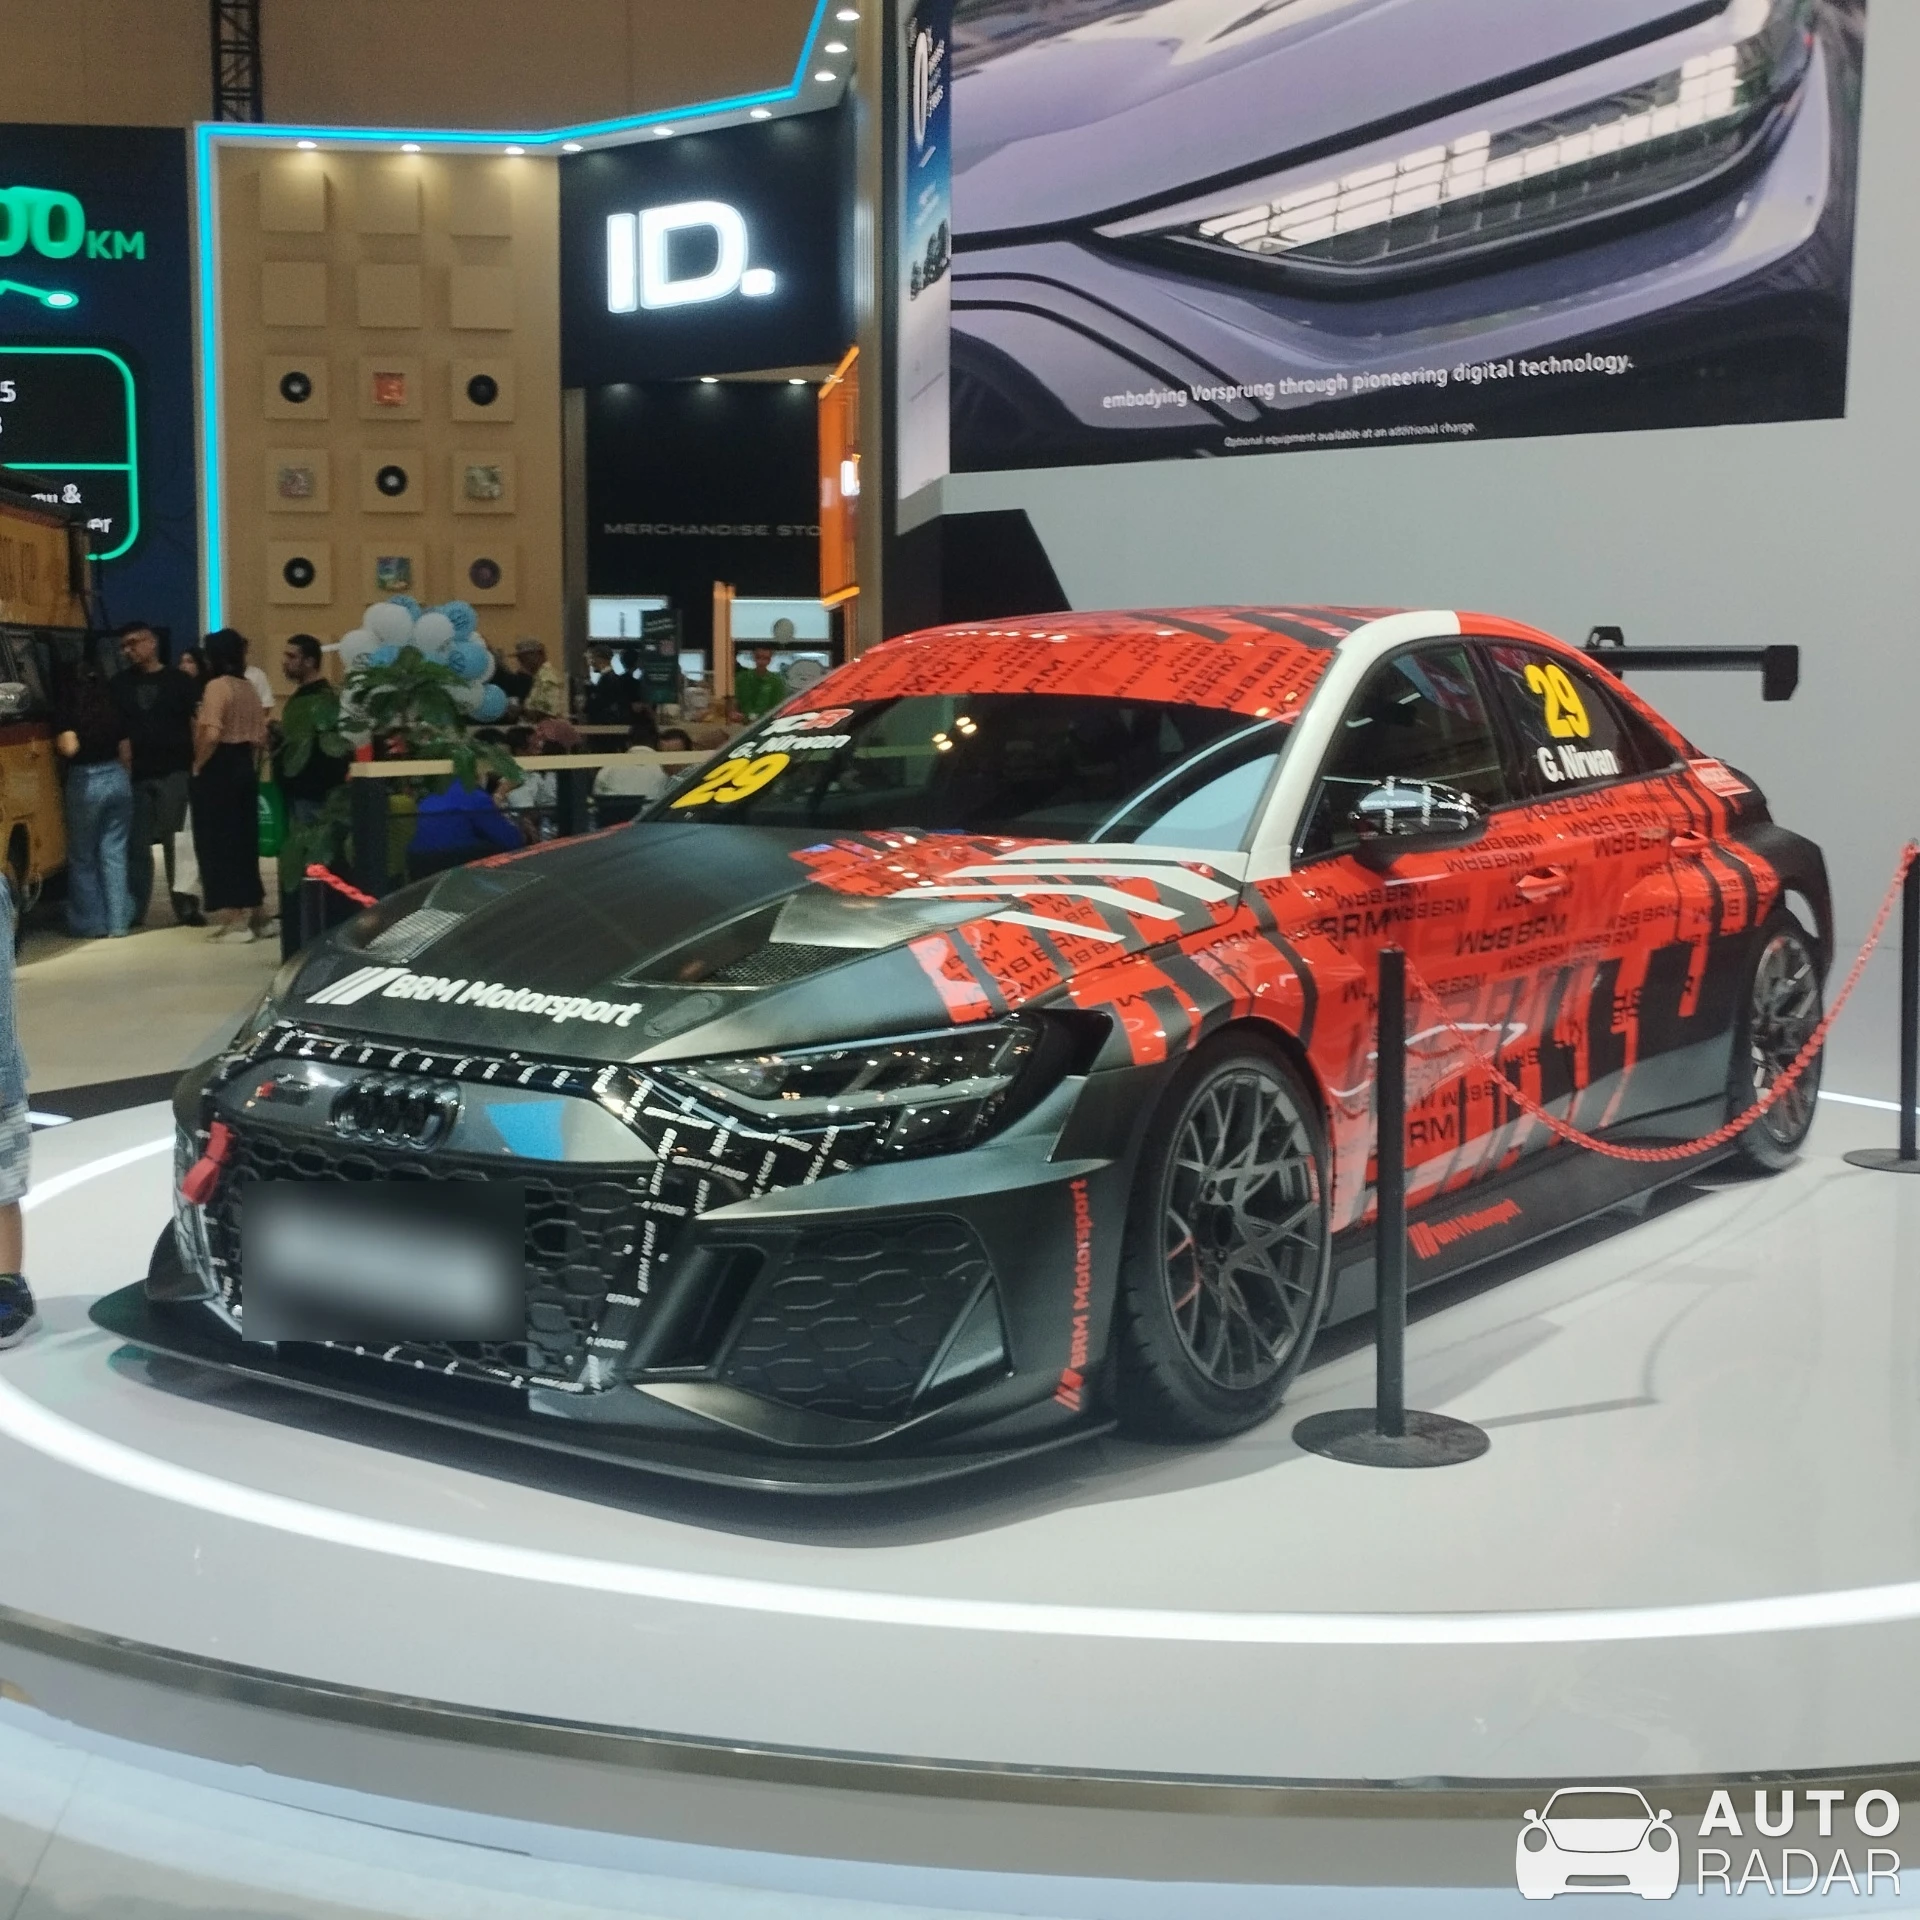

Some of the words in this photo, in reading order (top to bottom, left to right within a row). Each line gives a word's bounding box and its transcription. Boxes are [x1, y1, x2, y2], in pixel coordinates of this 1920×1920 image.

[606, 201, 776, 313] ID.
[1102, 387, 1188, 409] embodying
[1190, 380, 1275, 403] Vorsprung
[1278, 373, 1348, 397] through
[1352, 366, 1448, 393] pioneering
[1451, 359, 1515, 385] digital
[1519, 352, 1635, 376] technology.
[1265, 432, 1317, 446] equipment
[1317, 429, 1361, 443] available
[1361, 428, 1373, 440] at
[1373, 428, 1388, 439] an
[1388, 423, 1438, 438] additional
[604, 522, 770, 537] MERCHANDISE
[1524, 664, 1591, 739] 29
[669, 753, 791, 810] 29
[381, 974, 468, 1003] BRM
[454, 980, 645, 1028] Motorsport
[1408, 1113, 1456, 1146] RM
[1069, 1178, 1094, 1311] Motorsport
[1069, 1315, 1091, 1370] BRM
